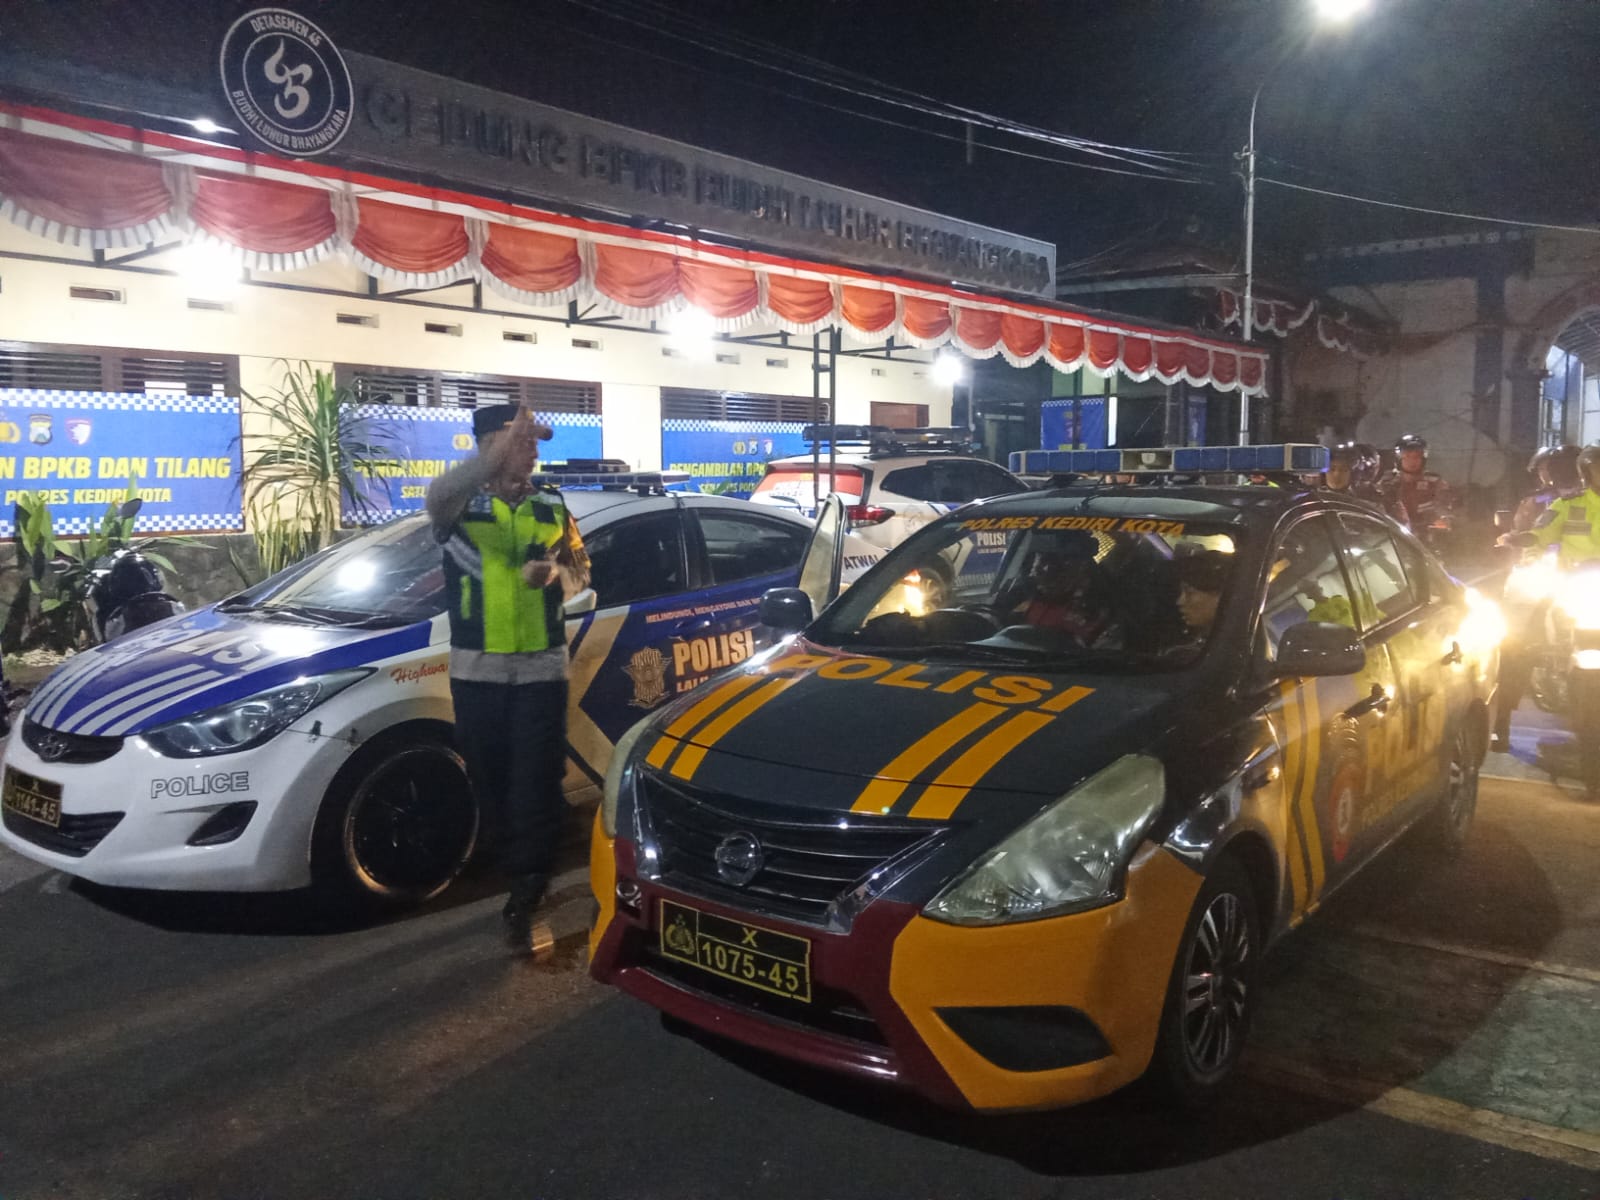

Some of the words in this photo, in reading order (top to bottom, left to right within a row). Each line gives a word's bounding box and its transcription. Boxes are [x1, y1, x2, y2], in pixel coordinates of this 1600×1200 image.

[250, 15, 309, 37] DETASEMEN
[308, 31, 322, 47] 45
[232, 90, 257, 124] BUDHI
[257, 119, 291, 148] LUHUR
[290, 109, 347, 149] BHAYANGKARA
[23, 457, 91, 479] BPKB
[98, 457, 147, 478] DAN
[154, 457, 231, 479] TILANG
[960, 517, 1038, 532] POLRES
[1038, 516, 1117, 532] KEDIRI
[1120, 518, 1185, 537] KOTA
[976, 532, 1007, 546] POLISI
[673, 630, 754, 676] POLISI
[762, 654, 1097, 712] POLISI
[151, 771, 249, 799] POLICE
[742, 927, 757, 947] X
[702, 942, 799, 992] 1075-45
